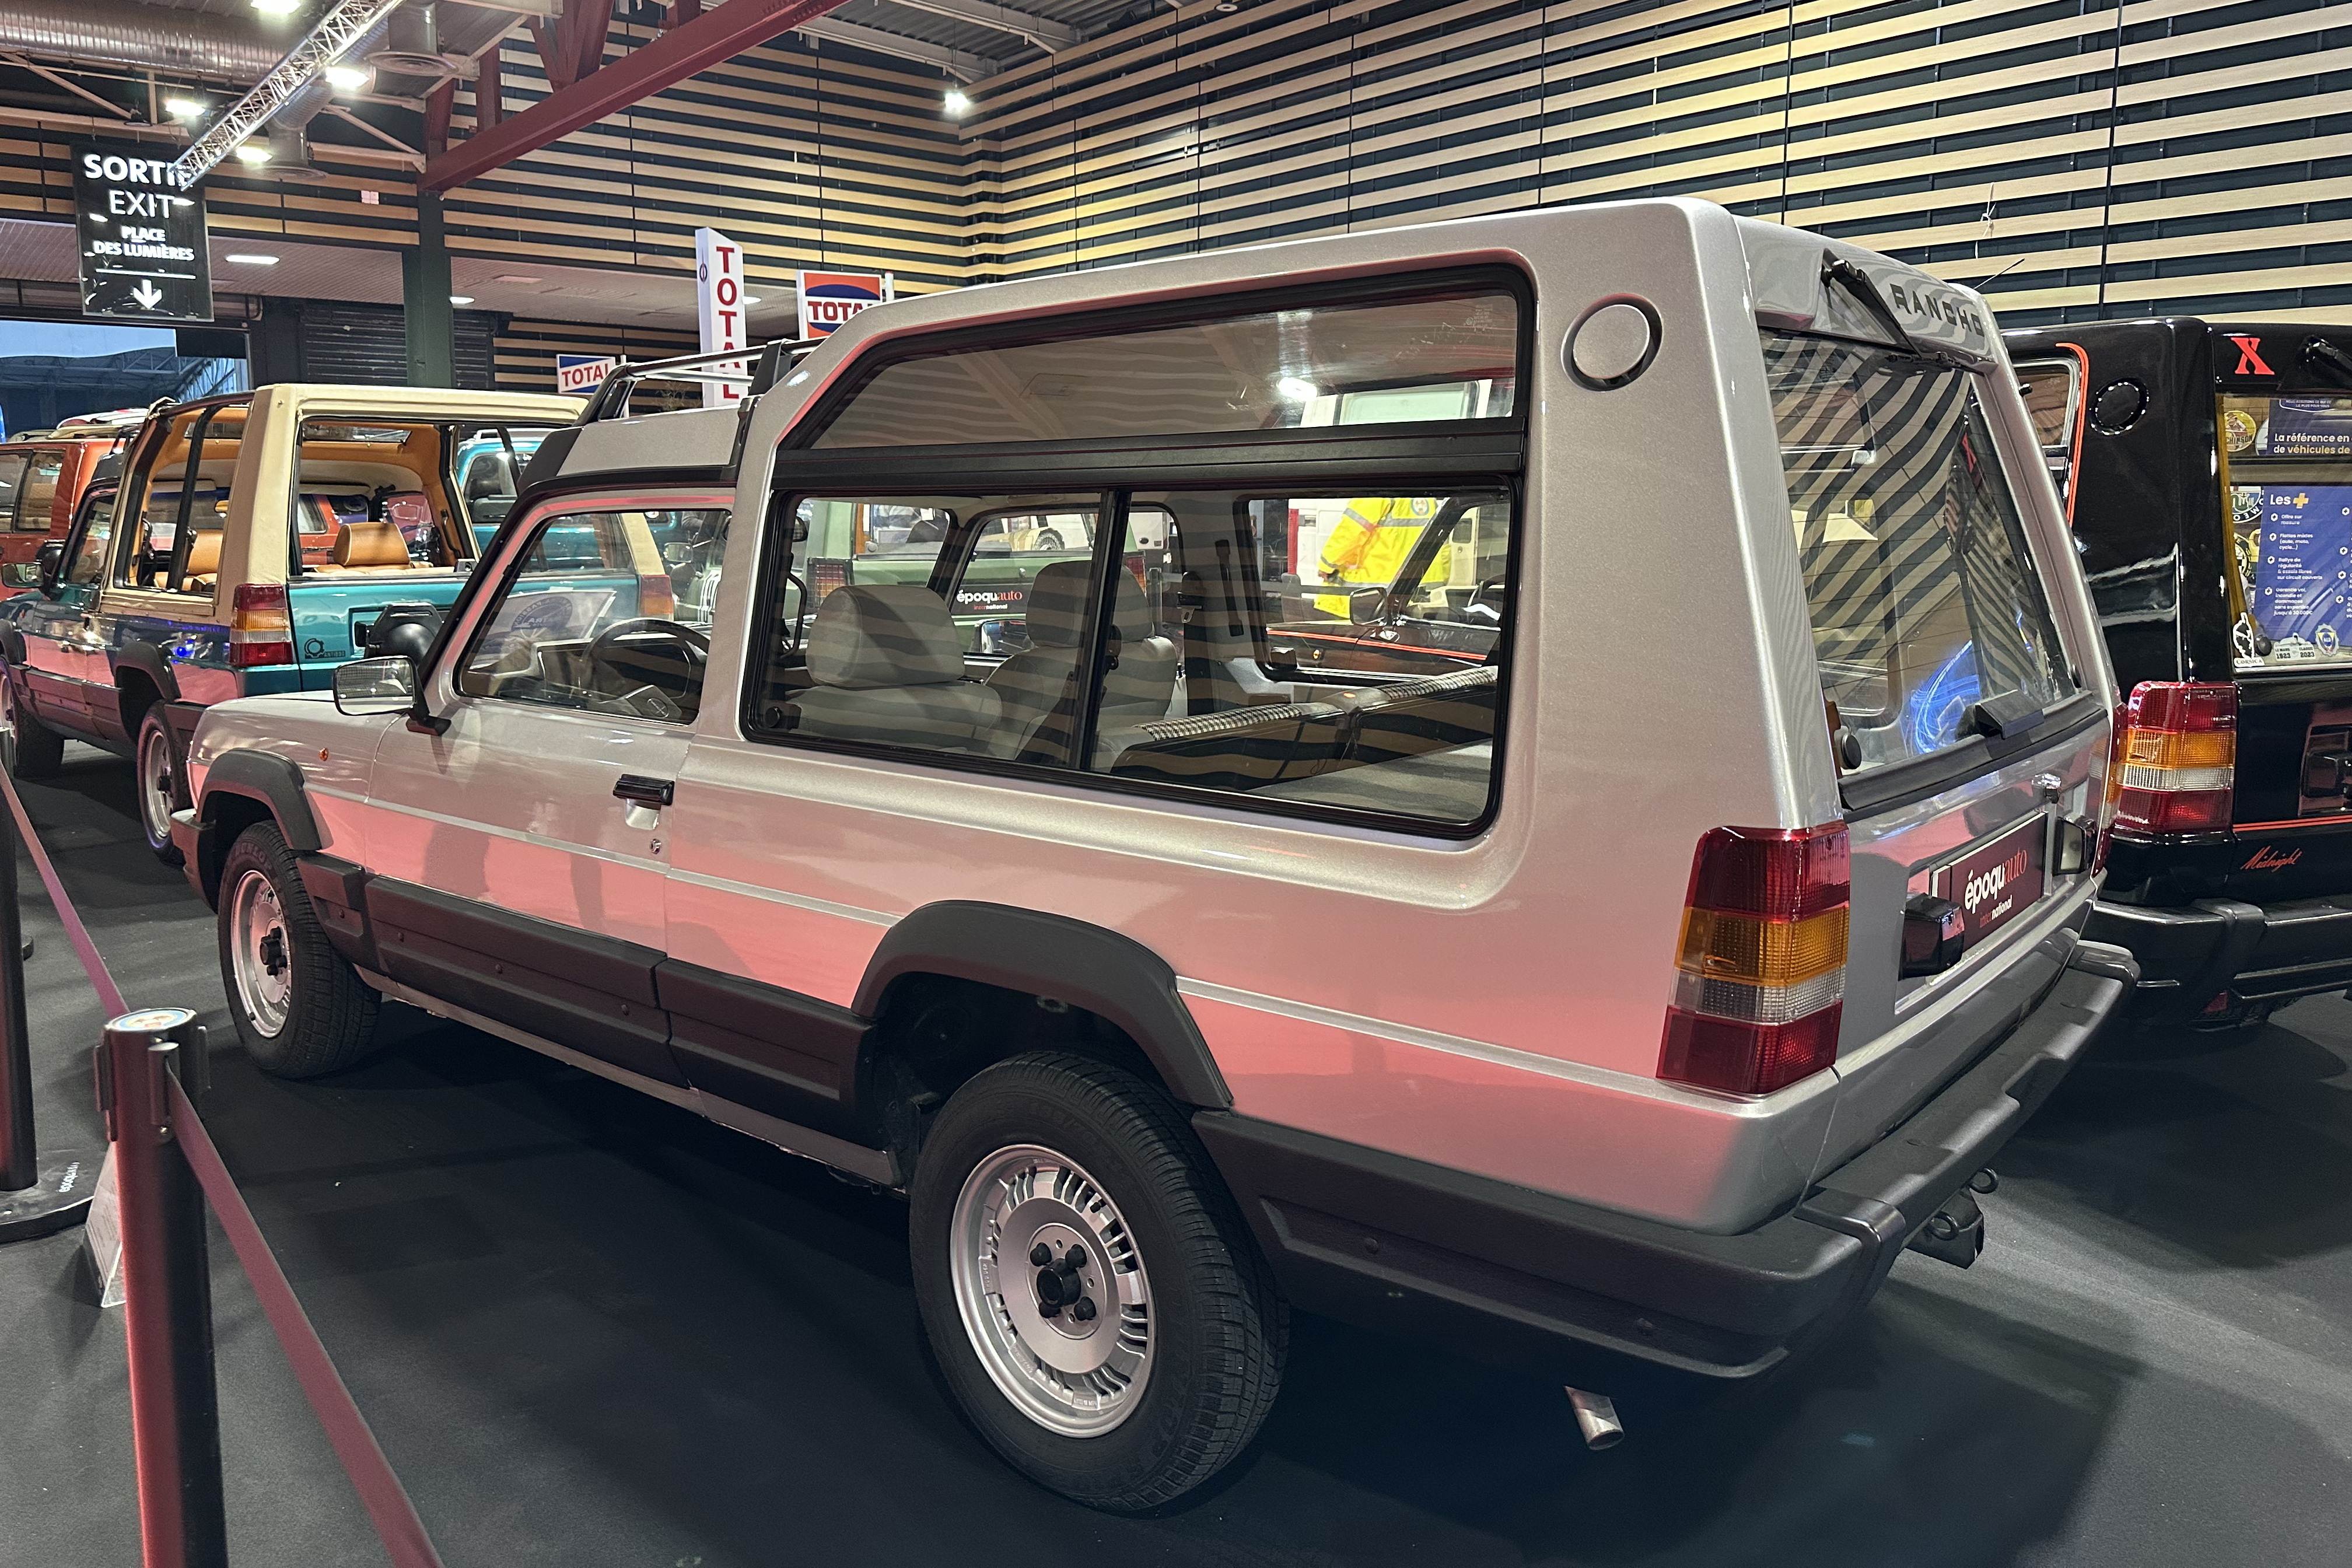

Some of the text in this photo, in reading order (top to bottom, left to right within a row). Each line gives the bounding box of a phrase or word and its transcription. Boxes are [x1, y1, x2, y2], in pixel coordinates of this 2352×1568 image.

[109, 190, 174, 218] EXIT
[121, 225, 166, 242] PLACE
[93, 240, 195, 261] DES LUMIÈRES
[807, 300, 873, 321] TOTA
[1889, 283, 1985, 337] RANCHO
[2231, 337, 2275, 375] X
[2226, 433, 2253, 444] CHINSON
[2274, 433, 2285, 442] La
[2287, 432, 2335, 442] référence
[2274, 444, 2350, 454] de véhicules de
[2270, 494, 2291, 505] Les
[957, 589, 1023, 604] époquauto
[2239, 845, 2302, 873] Midnight
[1964, 846, 2027, 915] époquauto
[1979, 894, 2013, 929] international
